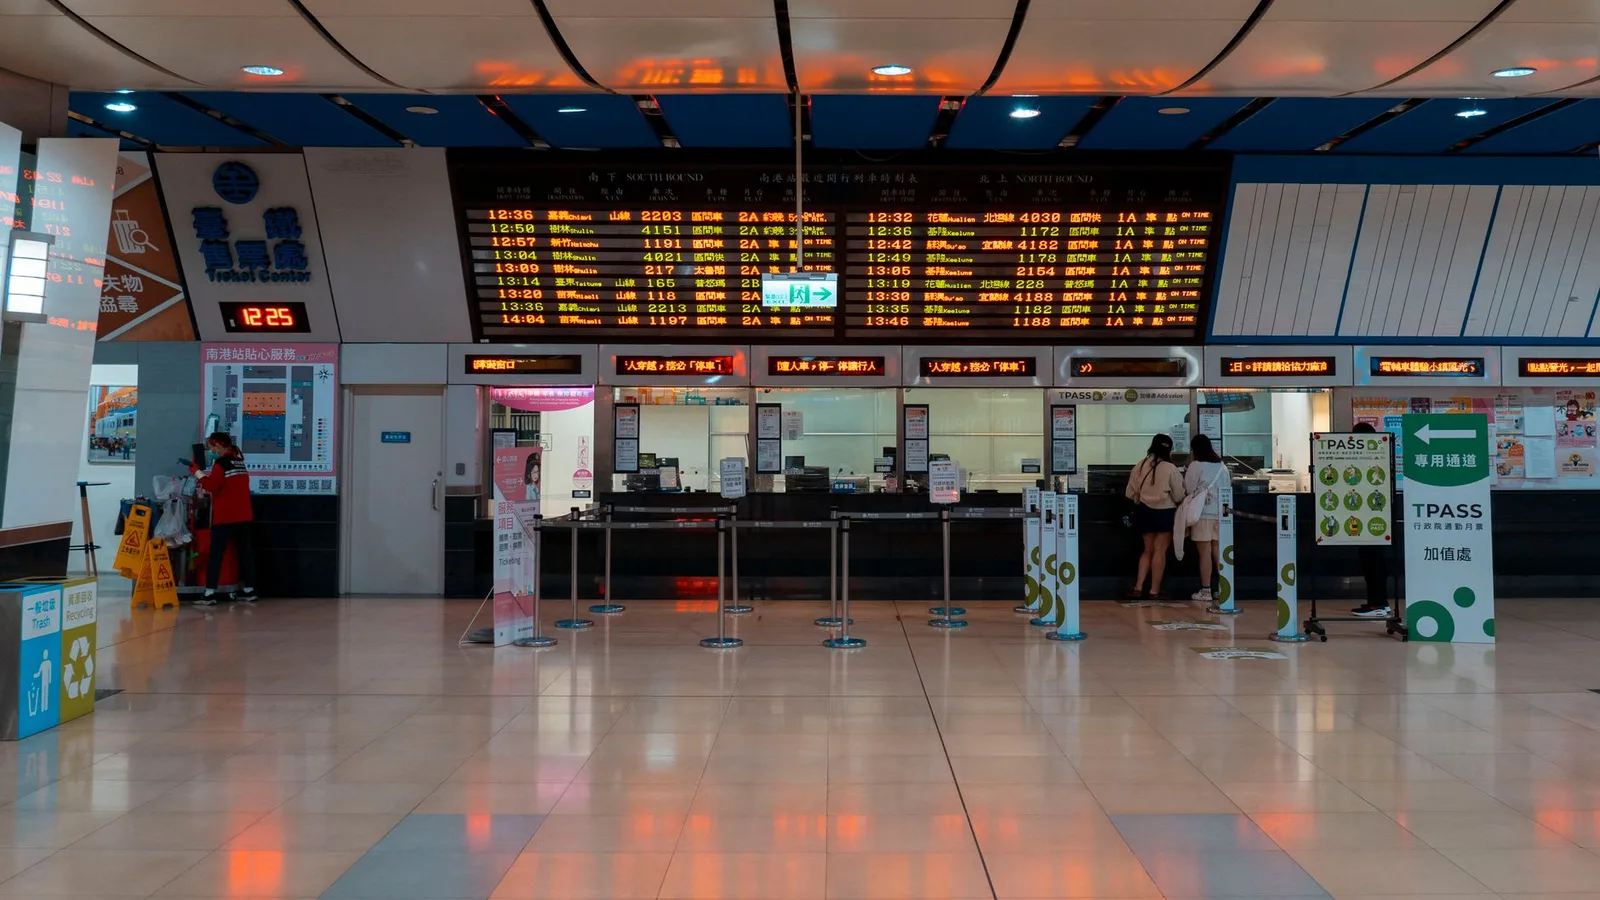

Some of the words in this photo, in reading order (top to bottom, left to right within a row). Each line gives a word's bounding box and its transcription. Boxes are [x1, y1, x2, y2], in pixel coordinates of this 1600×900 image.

[627, 173, 664, 182] SOUTH
[666, 173, 704, 182] BOUND
[489, 210, 533, 220] 12:36
[641, 211, 682, 221] 2203
[739, 212, 759, 222] 2A
[868, 213, 912, 222] 12:32
[1020, 213, 1060, 223] 4030
[1118, 213, 1136, 222] 1A
[491, 224, 535, 233] 12:50
[642, 225, 681, 235] 4151
[740, 226, 759, 235] 2A
[868, 227, 912, 236] 12:36
[1021, 227, 1059, 236] 1172
[1117, 227, 1134, 236] 1A
[493, 237, 536, 247] 12:57
[644, 239, 681, 248] 1191
[740, 239, 759, 249] 2A
[868, 240, 912, 250] 12:42
[1018, 240, 1058, 250] 4182
[1115, 240, 1133, 249] 1A
[495, 251, 537, 259] 13:04
[643, 252, 682, 262] 4021
[741, 253, 759, 262] 2A
[868, 254, 911, 262] 12:49
[1018, 254, 1056, 263] 1178
[1114, 254, 1131, 262] 1A
[496, 263, 539, 273] 13:09
[645, 266, 674, 275] 217
[740, 266, 759, 275] 2A
[867, 267, 911, 275] 13:05
[1017, 267, 1055, 276] 2154
[1112, 267, 1130, 275] 1A
[205, 269, 256, 282] Ticket
[259, 269, 311, 282] Center
[498, 277, 540, 286] 13:14
[648, 279, 675, 287] 165
[741, 279, 759, 287] 2B
[868, 279, 910, 288] 13:19
[1016, 280, 1044, 289] 228
[1110, 280, 1128, 288] 1A
[499, 289, 542, 298] 13:20
[648, 291, 676, 301] 118
[742, 291, 760, 301] 2A
[867, 292, 910, 301] 13:30
[1013, 293, 1053, 302] 4188
[1109, 293, 1127, 301] 1A
[501, 302, 544, 311] 13:36
[649, 304, 686, 313] 2213
[743, 304, 761, 313] 2A
[867, 305, 909, 313] 13:35
[1014, 305, 1051, 314] 1182
[1108, 305, 1125, 314] 1A
[503, 315, 545, 323] 14:04
[650, 317, 687, 325] 1197
[743, 317, 761, 325] 2A
[866, 317, 908, 325] 13:46
[1013, 318, 1051, 326] 1188
[1106, 318, 1123, 326] 1A
[206, 347, 297, 361] 南港站貼心服務
[1059, 391, 1092, 400] TPASS
[1318, 439, 1364, 450] TPASS
[1414, 453, 1477, 468] 專用通道
[1412, 504, 1483, 518] TPASS
[498, 518, 514, 531] 項目
[1413, 522, 1484, 531] 行政院通勤月票
[1423, 547, 1472, 562] 加值處
[67, 590, 93, 607] 資源回收
[27, 597, 56, 615] 一般垃圾
[66, 606, 94, 623] Recycling
[32, 616, 51, 631] Trash
